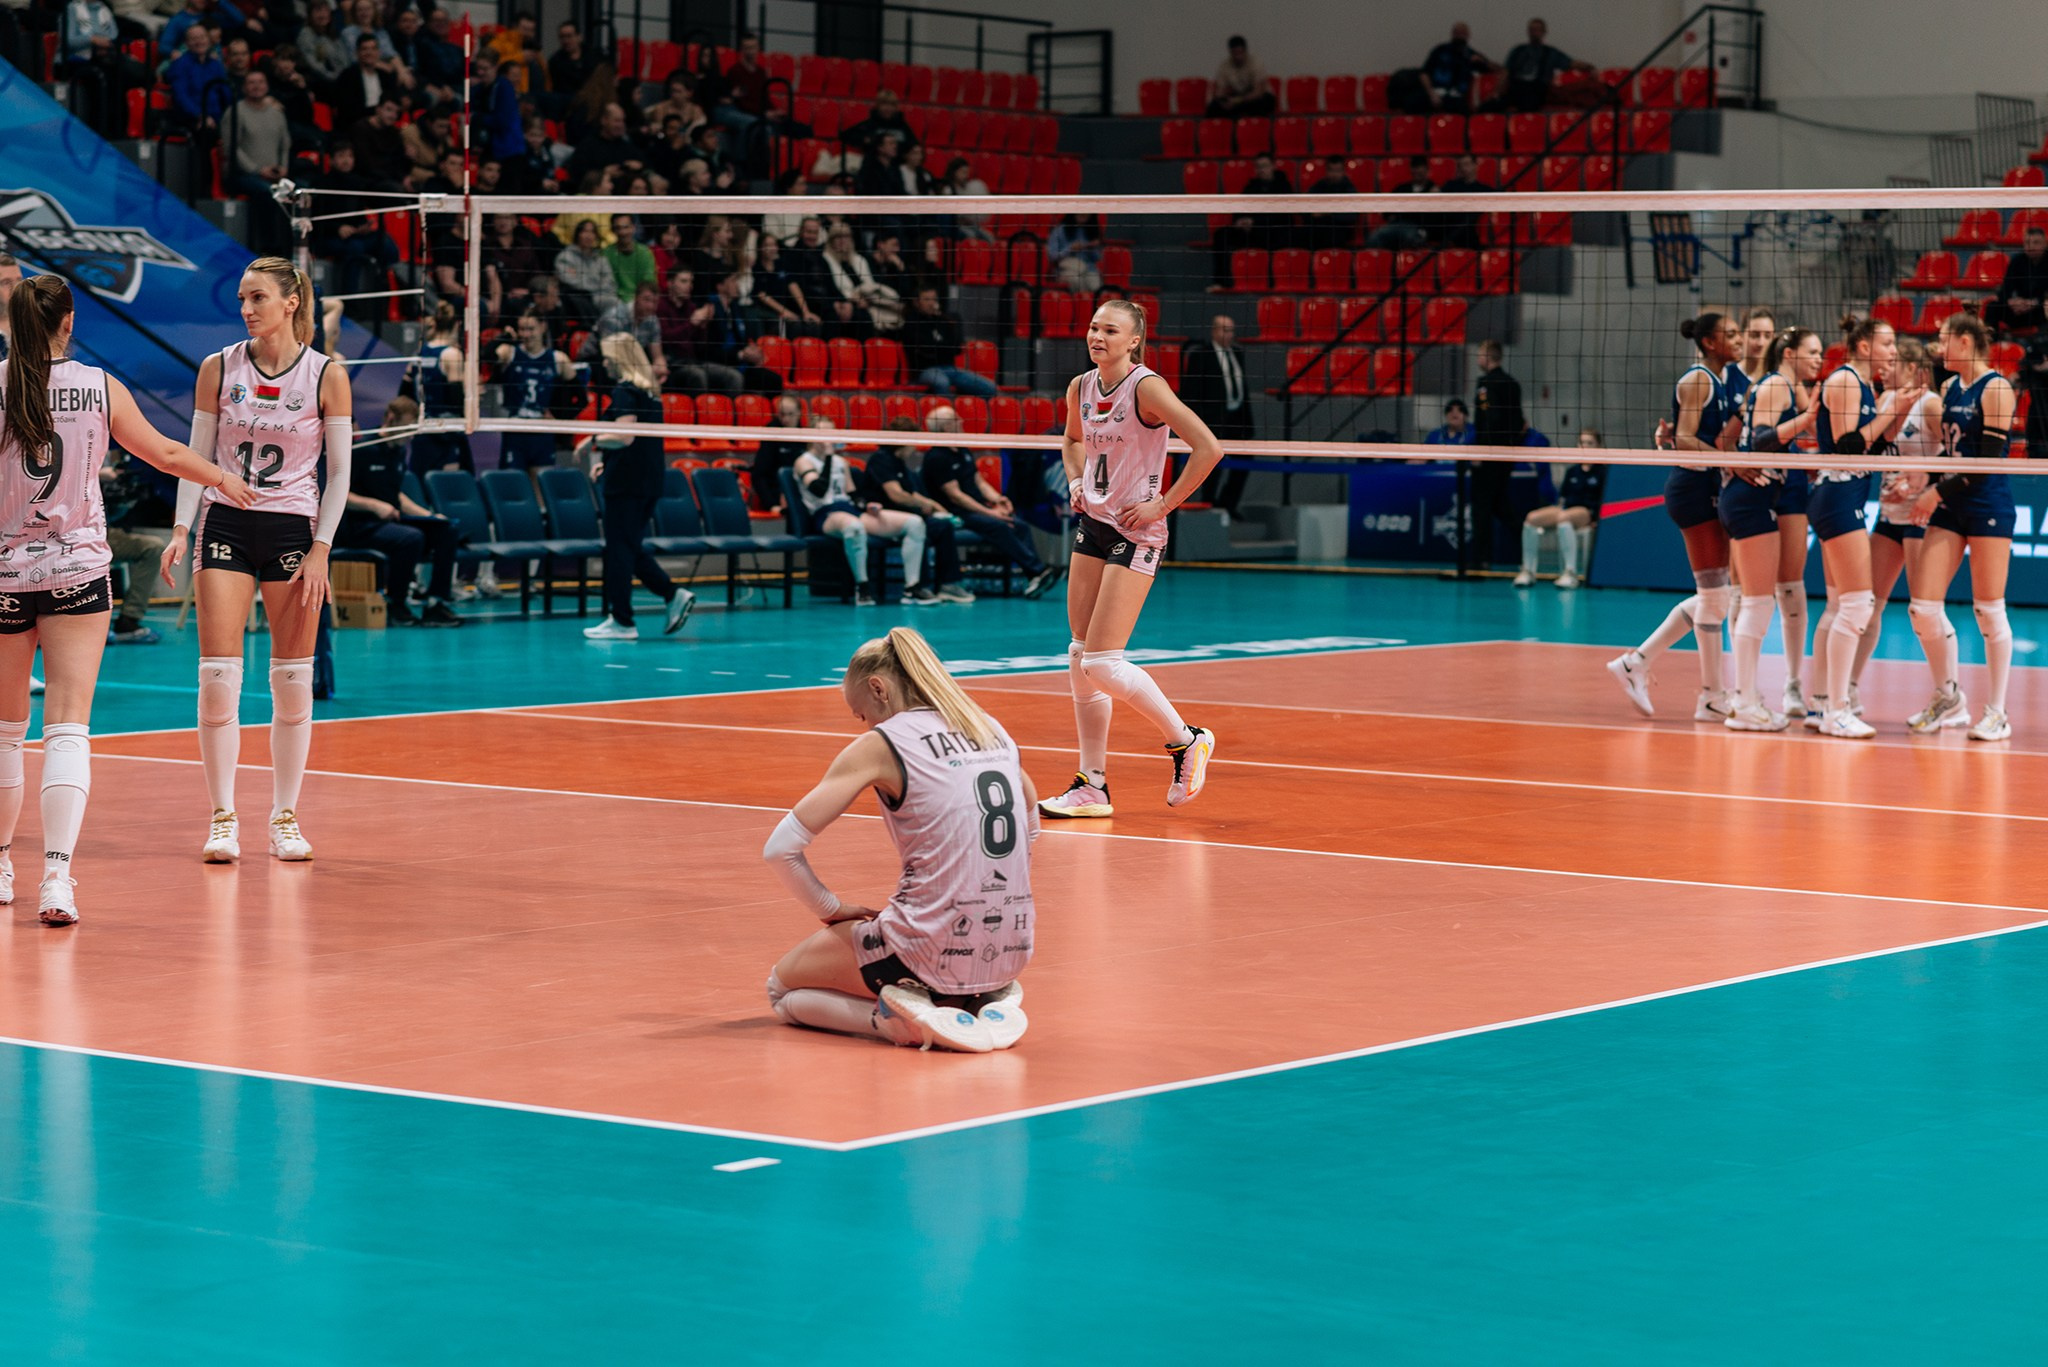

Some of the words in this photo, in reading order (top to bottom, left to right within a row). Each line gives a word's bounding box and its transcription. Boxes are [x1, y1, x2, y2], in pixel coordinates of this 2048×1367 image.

[1086, 428, 1124, 449] RIZMA
[21, 428, 63, 504] 9
[234, 441, 285, 489] 12
[1094, 454, 1109, 498] 4
[209, 542, 232, 560] 12
[973, 770, 1016, 859] 8
